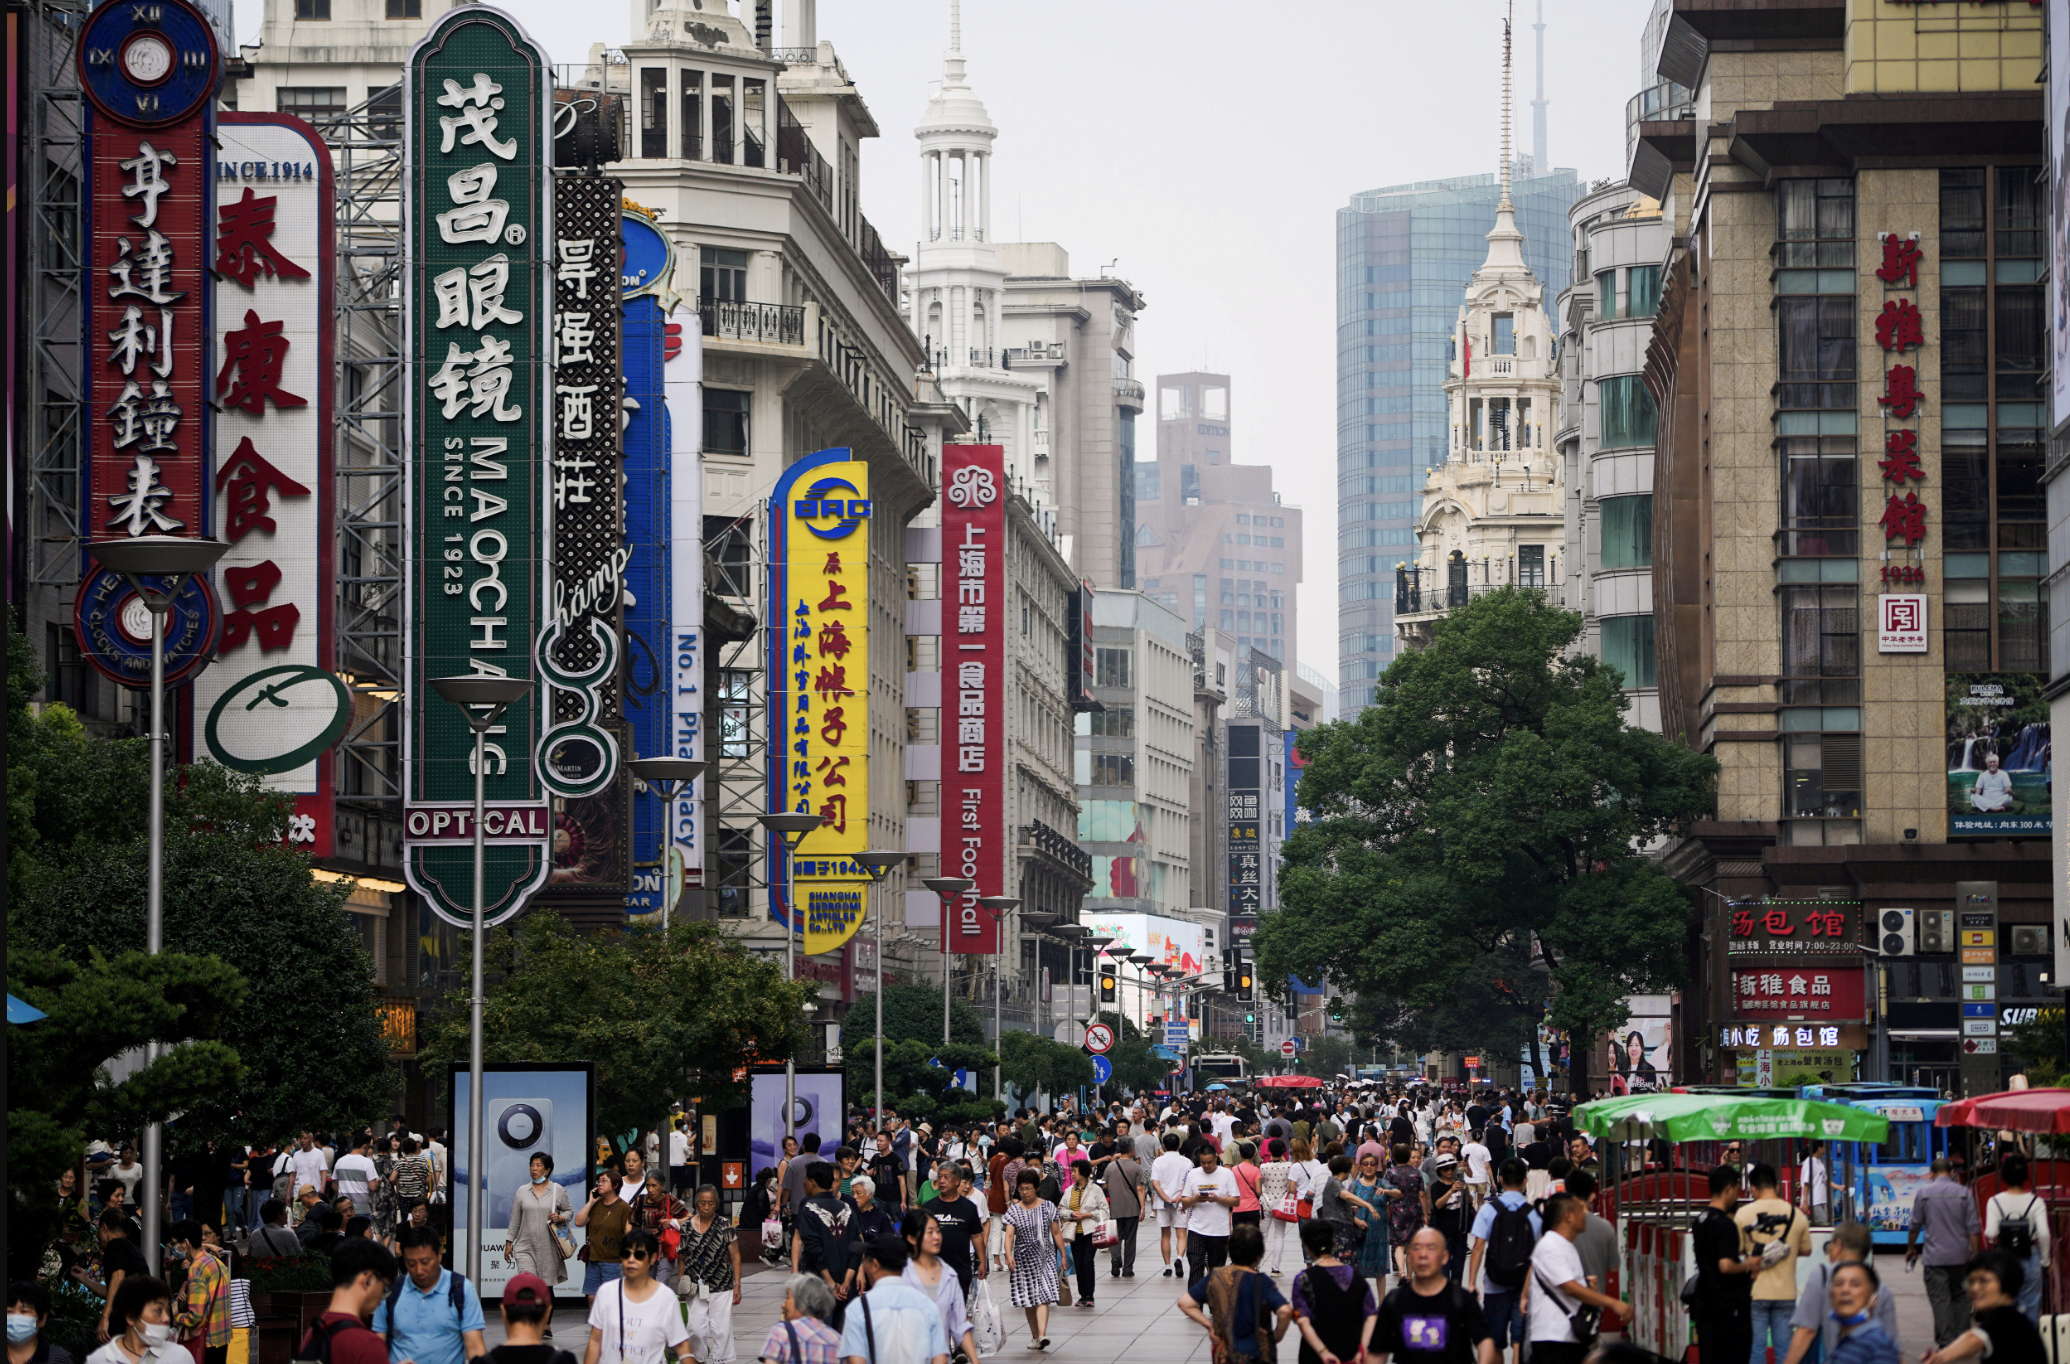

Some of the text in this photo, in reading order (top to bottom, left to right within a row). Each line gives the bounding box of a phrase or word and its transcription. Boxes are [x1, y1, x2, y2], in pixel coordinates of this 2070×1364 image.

[217, 161, 313, 178] INCE.1914
[427, 72, 524, 422] 茂昌眼镜
[216, 186, 312, 654] 泰康食品
[1197, 423, 1230, 437] EDITION
[444, 437, 464, 595] SINCE 1923
[794, 499, 872, 518] BAC
[554, 542, 635, 627] hamp
[1880, 565, 1925, 582] 1926
[957, 522, 986, 773] 上海市第一食品商店
[678, 634, 697, 696] No.1
[675, 712, 698, 849] Phamacy
[962, 789, 981, 831] First
[408, 811, 544, 836] OPTCAL
[808, 891, 862, 901] SHANGHAI
[961, 838, 981, 935] Foodhall
[808, 912, 857, 921] ARTICLES
[1732, 909, 1845, 937] 汤包馆
[1769, 940, 1803, 951] 营业时间
[1740, 973, 1831, 996] 新雅食品
[1720, 1026, 1839, 1047] 海小吃 汤包馆
